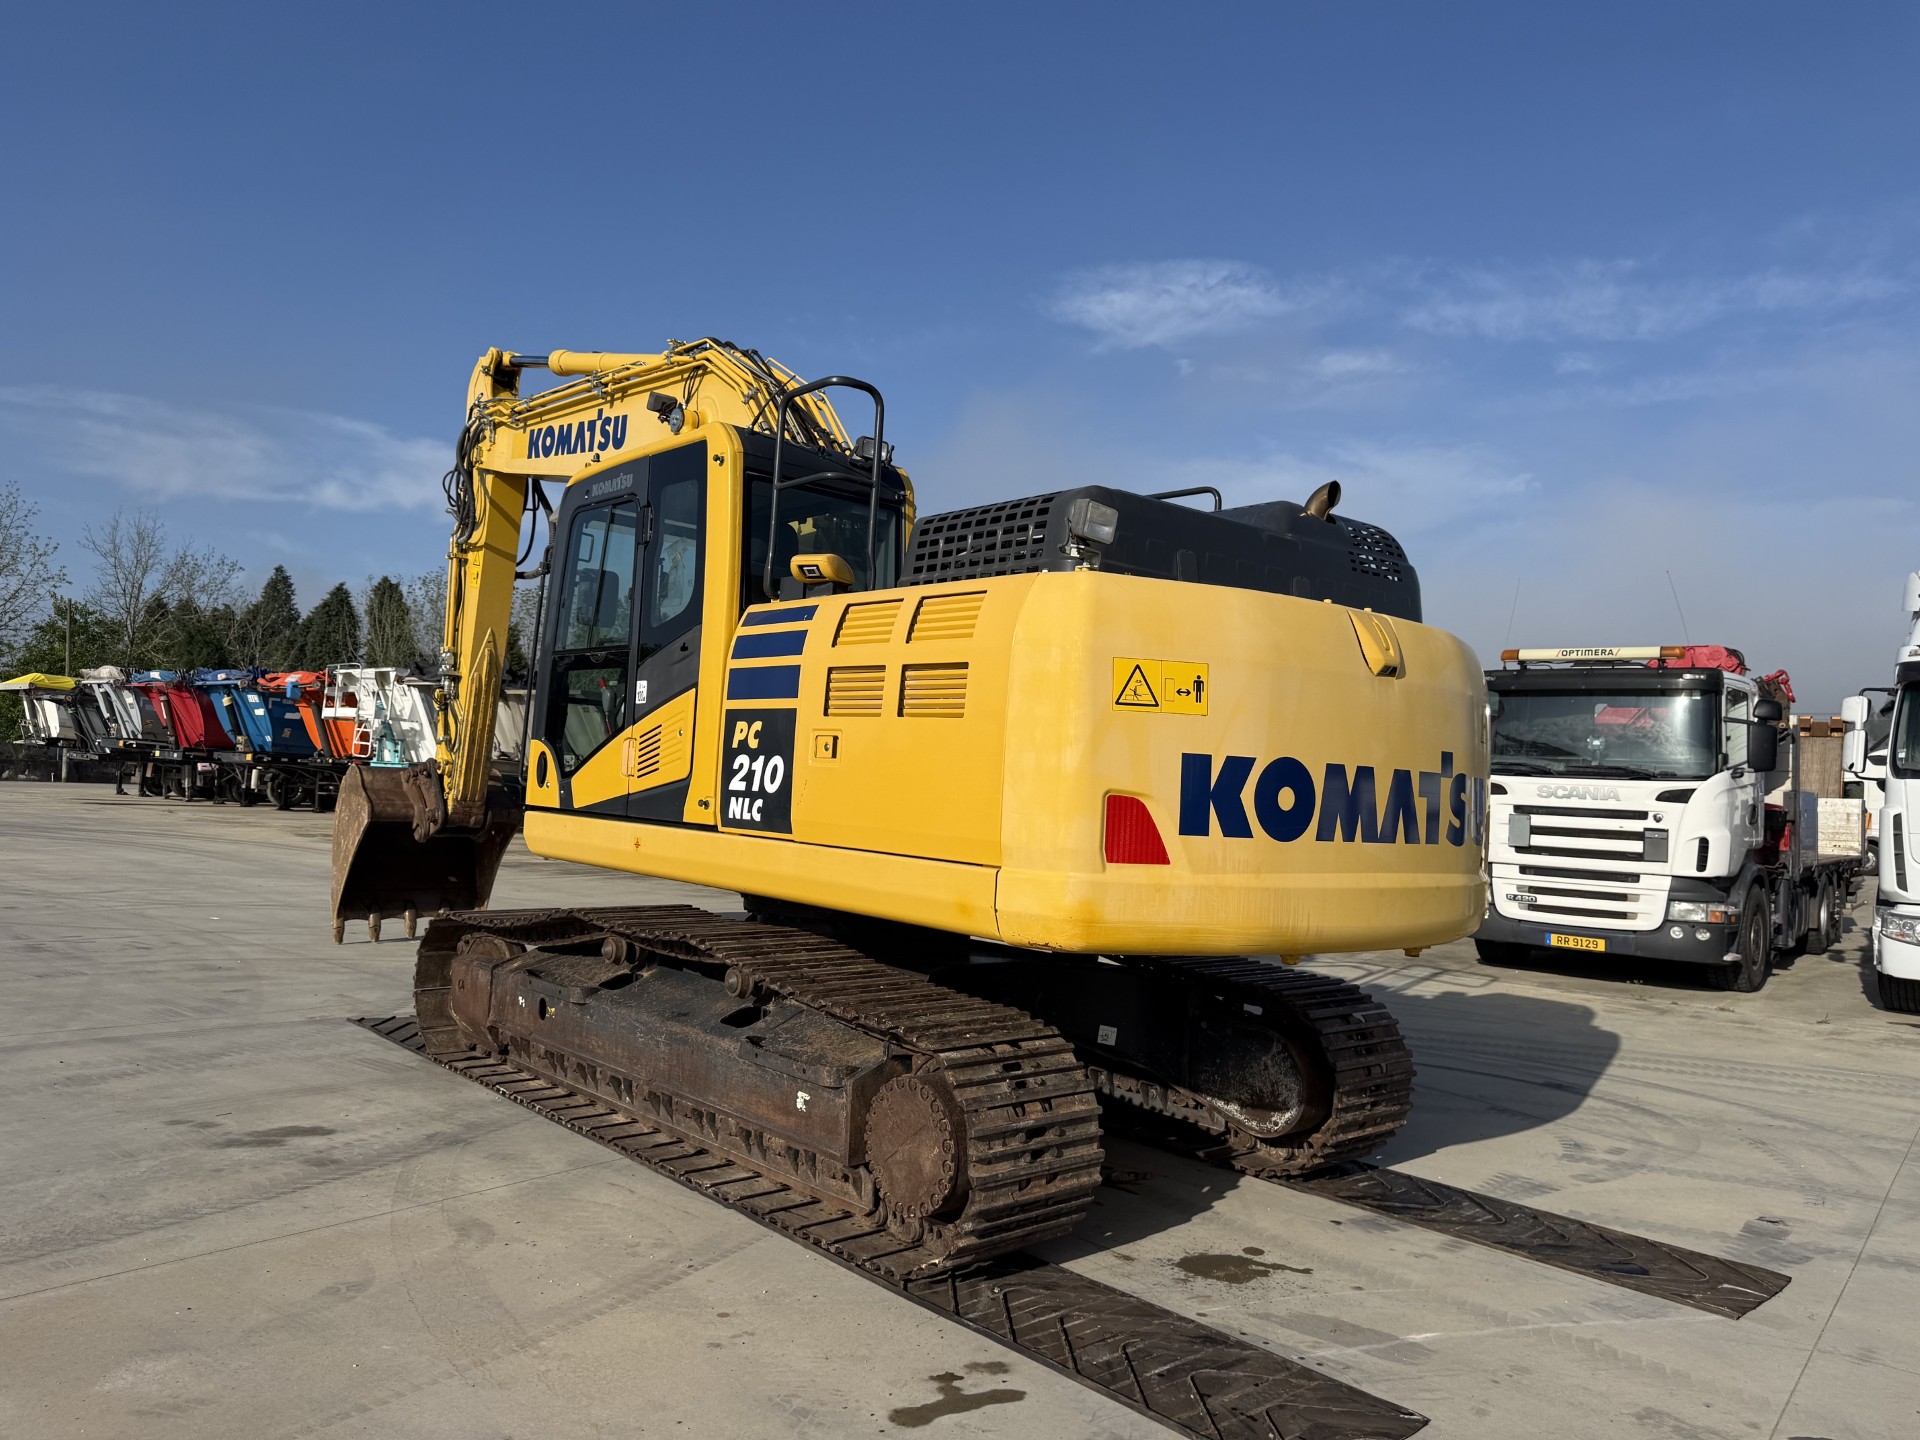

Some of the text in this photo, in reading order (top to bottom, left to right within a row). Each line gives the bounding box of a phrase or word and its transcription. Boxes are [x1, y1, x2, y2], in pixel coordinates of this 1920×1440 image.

[527, 408, 628, 459] KOMATSU
[592, 472, 634, 497] KOMATSU
[731, 721, 763, 749] PC
[728, 754, 785, 794] 210
[1179, 750, 1484, 847] KOMATSU
[1536, 784, 1621, 801] SCANIA
[728, 796, 764, 822] NLC
[1556, 936, 1599, 949] RR 9129
